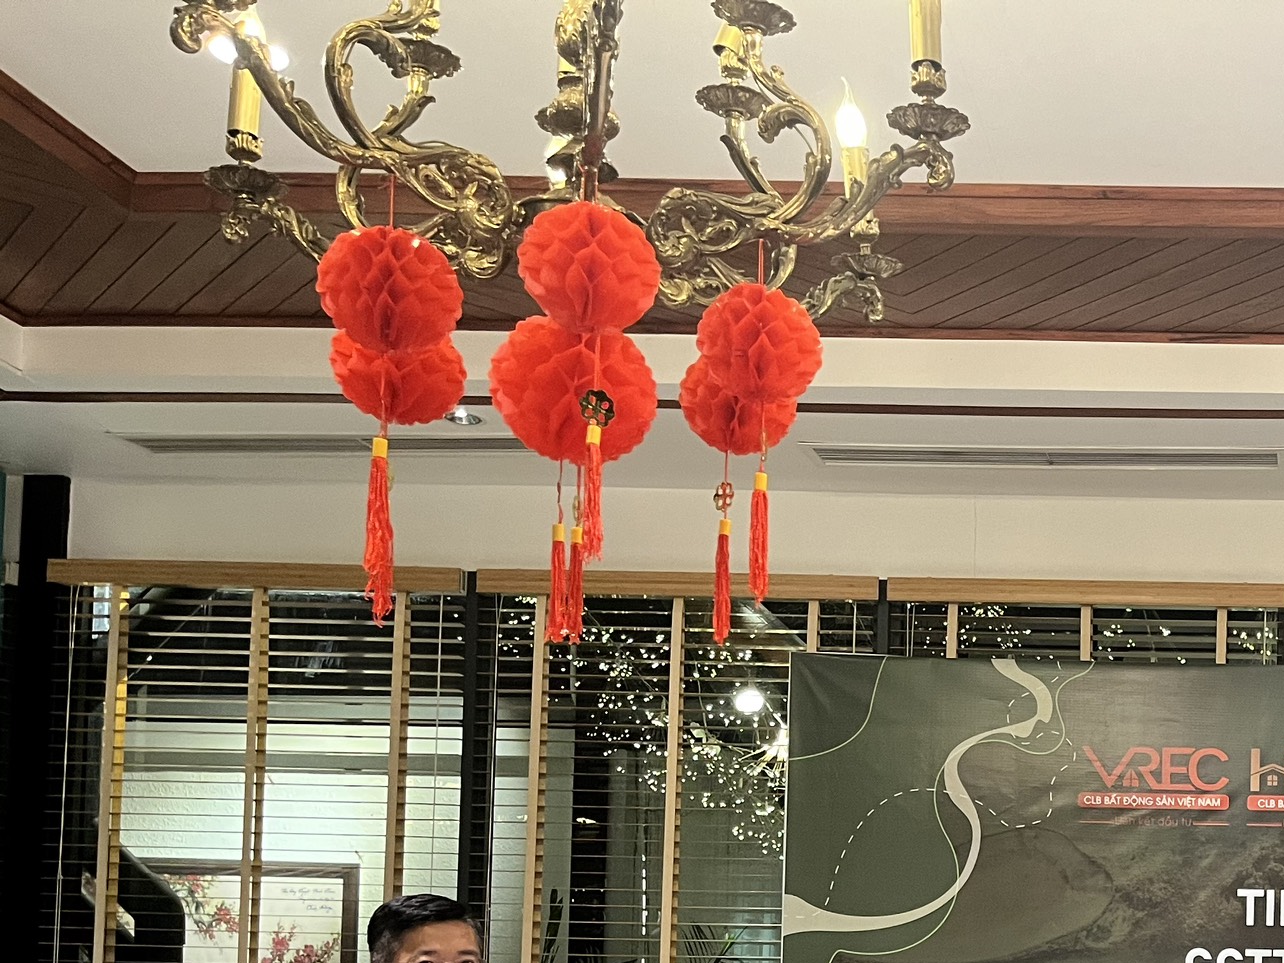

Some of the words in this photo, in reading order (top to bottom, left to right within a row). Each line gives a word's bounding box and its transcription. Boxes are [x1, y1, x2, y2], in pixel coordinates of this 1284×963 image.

[1082, 745, 1230, 792] VREC
[1083, 795, 1102, 805] CLB
[1104, 793, 1121, 805] BẤT
[1123, 794, 1152, 807] ĐỘNG
[1156, 794, 1175, 806] SẢN
[1177, 796, 1196, 808] VIỆT
[1198, 797, 1221, 807] NAM
[1257, 799, 1276, 808] CLB
